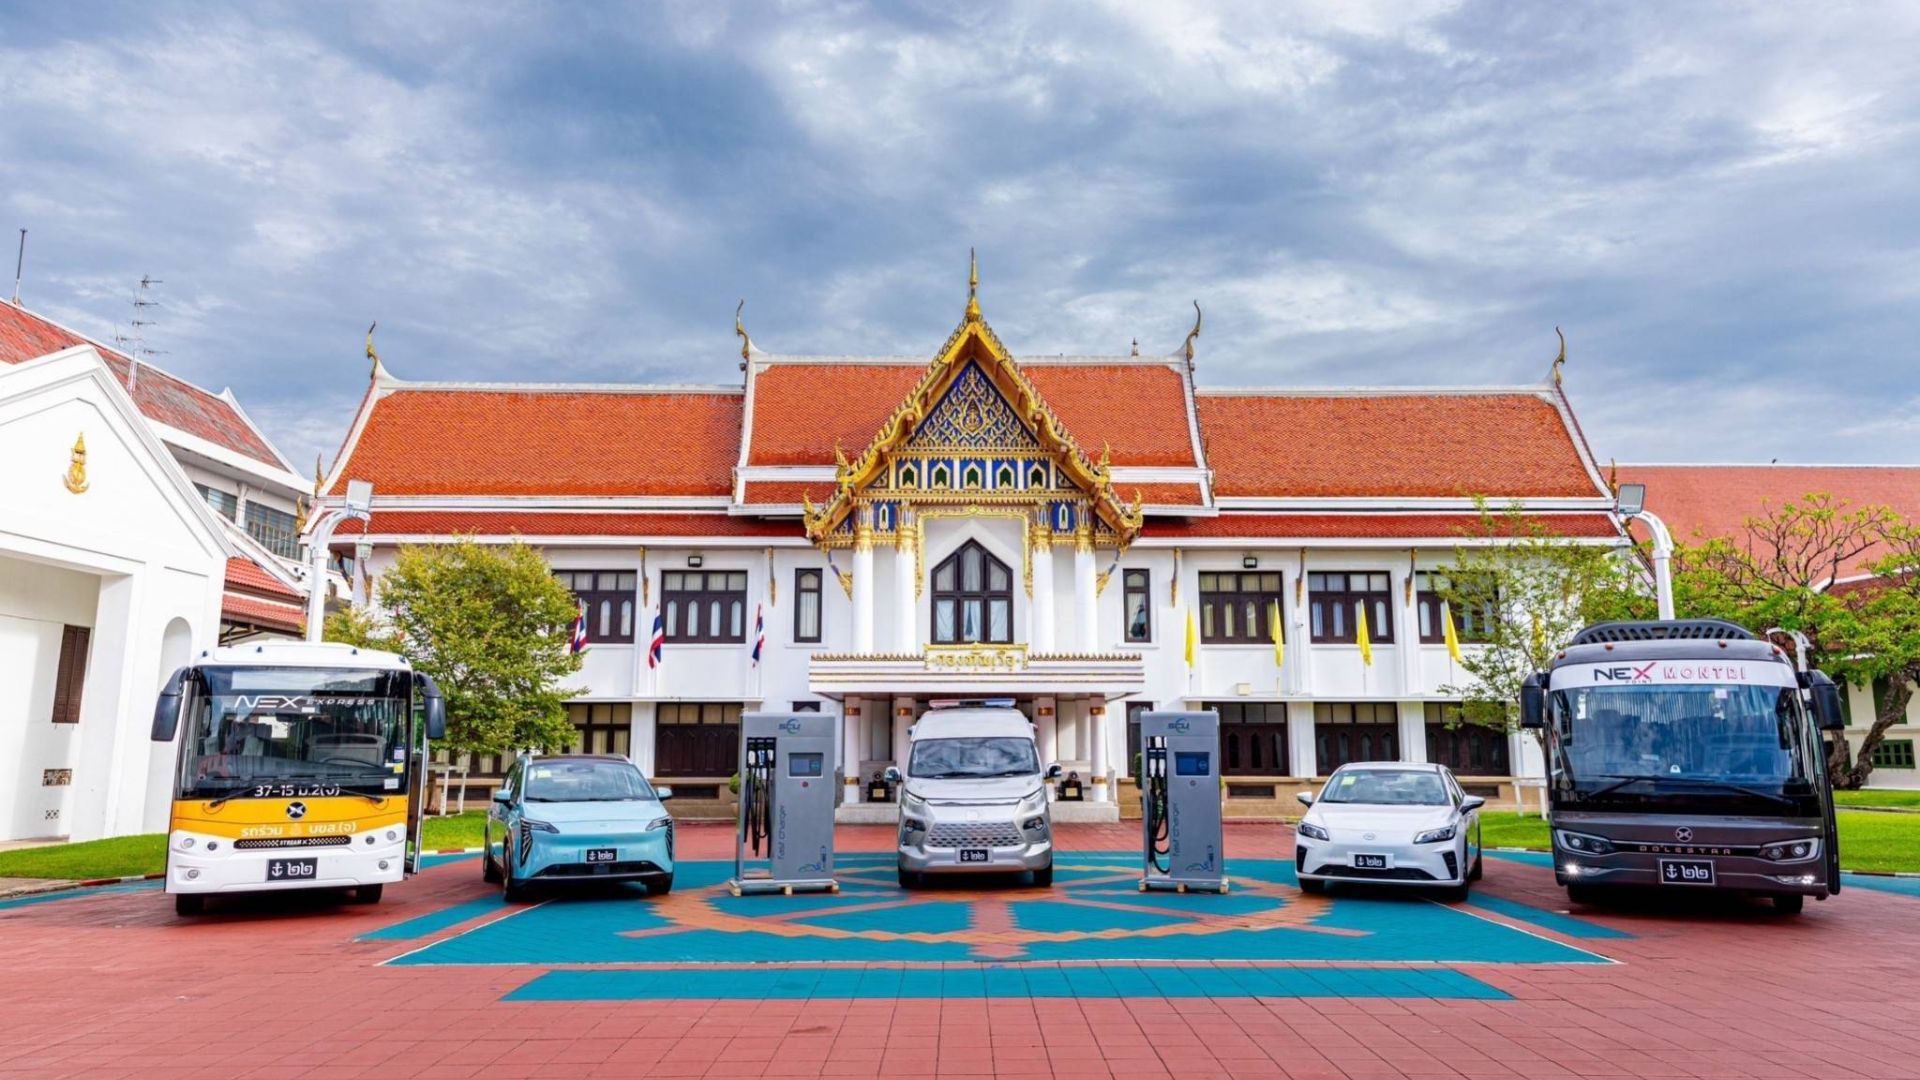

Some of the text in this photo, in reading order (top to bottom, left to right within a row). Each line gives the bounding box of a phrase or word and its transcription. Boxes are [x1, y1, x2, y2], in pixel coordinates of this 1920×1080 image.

[1594, 661, 1747, 681] NEX MONTRI
[234, 695, 376, 709] NEX EXPRESS
[254, 785, 295, 797] 37-15
[287, 862, 313, 876] ๒๒
[1680, 865, 1709, 879] ๒๒
